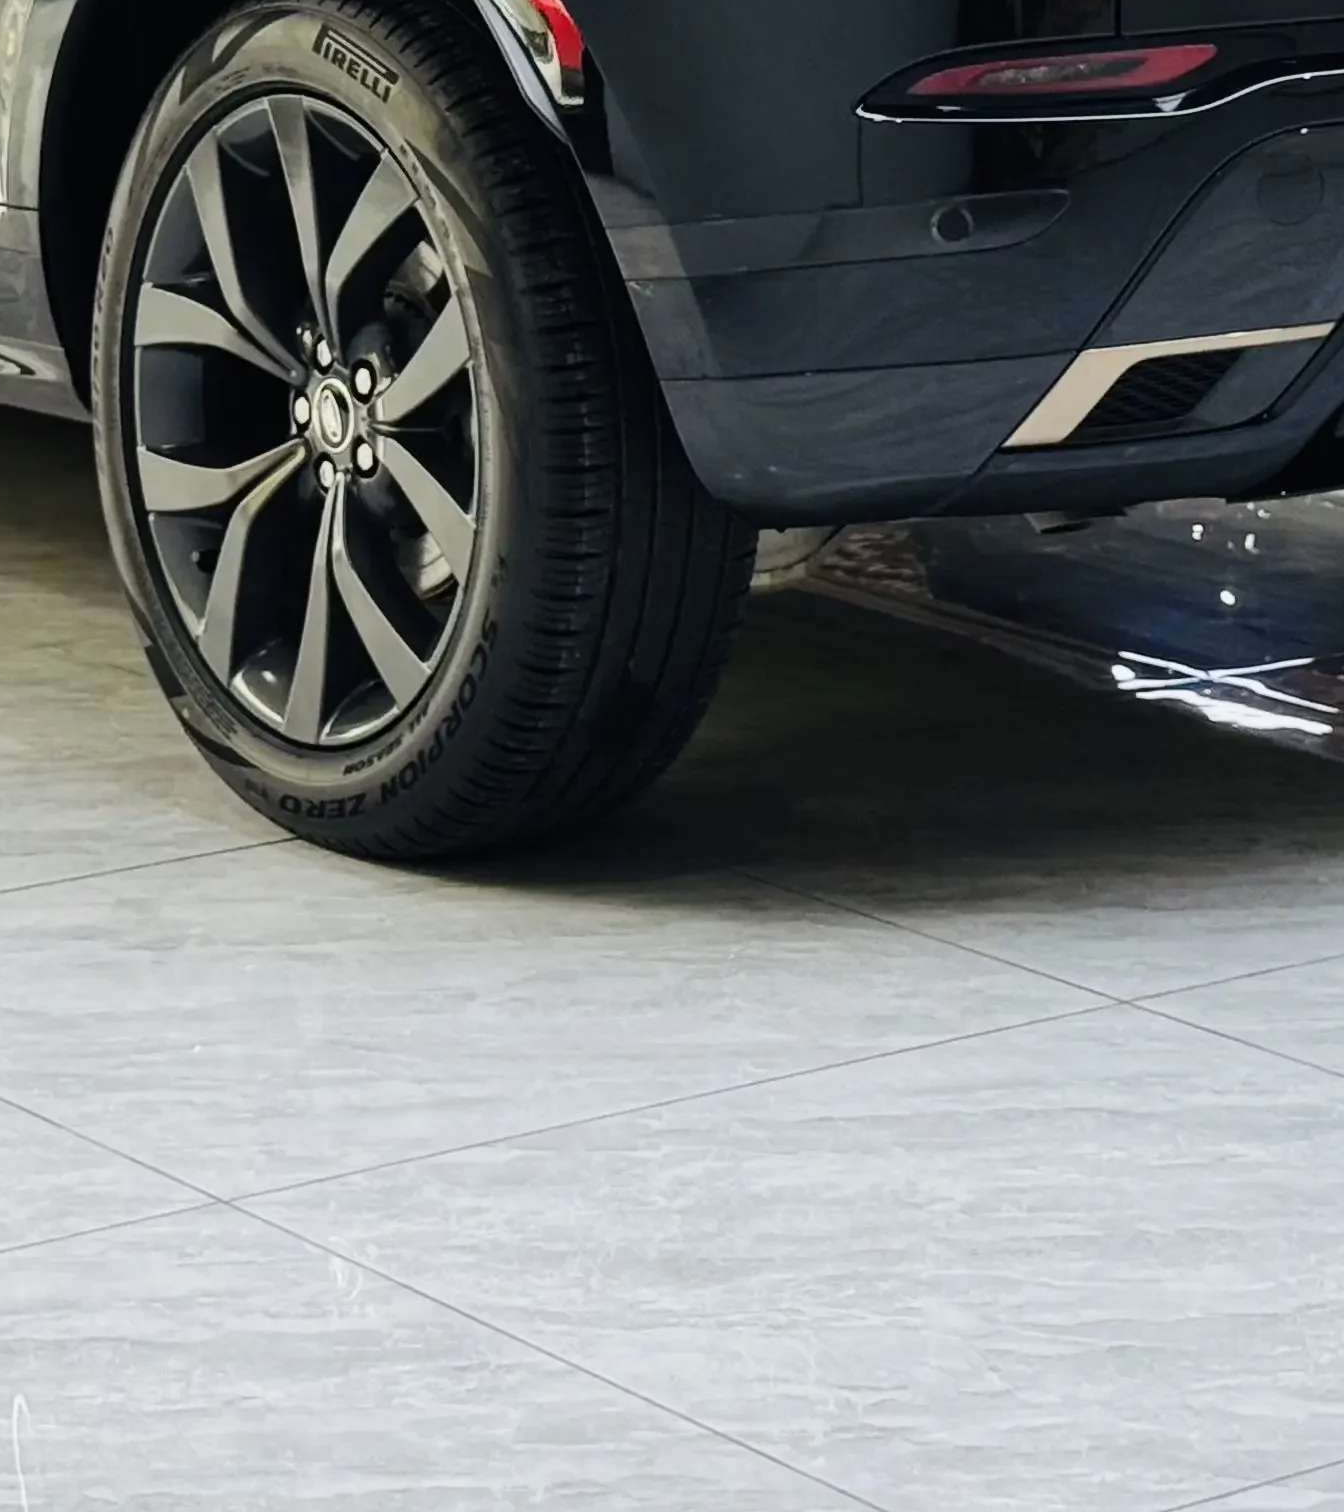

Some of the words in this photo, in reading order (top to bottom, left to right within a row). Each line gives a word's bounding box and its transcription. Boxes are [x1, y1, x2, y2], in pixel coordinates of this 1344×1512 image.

[311, 20, 401, 104] PIRELLI
[380, 608, 499, 806] SCORPION
[278, 792, 368, 820] ZERO
